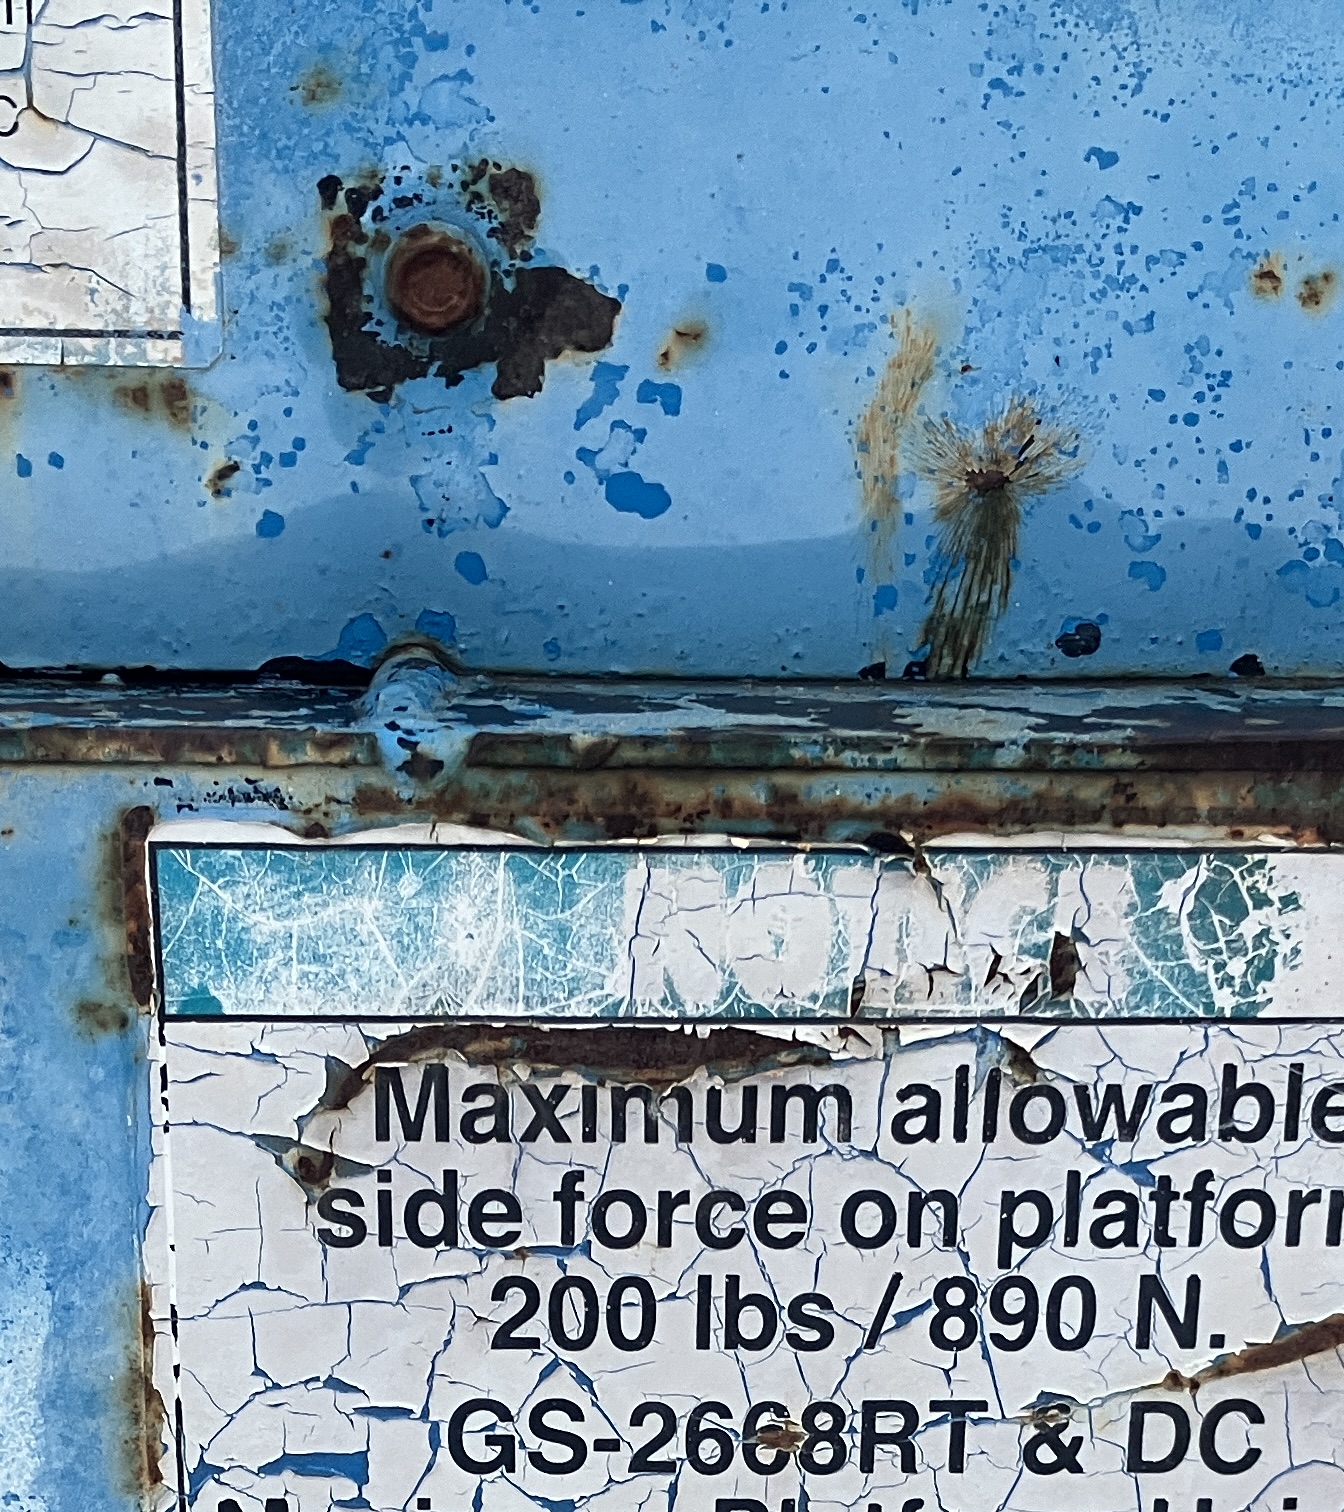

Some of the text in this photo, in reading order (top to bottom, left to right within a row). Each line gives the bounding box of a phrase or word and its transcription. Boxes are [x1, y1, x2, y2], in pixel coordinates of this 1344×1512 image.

[375, 1066, 852, 1144] Maximum
[316, 1169, 522, 1250] side
[553, 1170, 807, 1249] force
[841, 1180, 958, 1249] on
[491, 1272, 1225, 1352] 200 lbs / 890 N.
[448, 1399, 1264, 1475] GS-2668RT & DC
